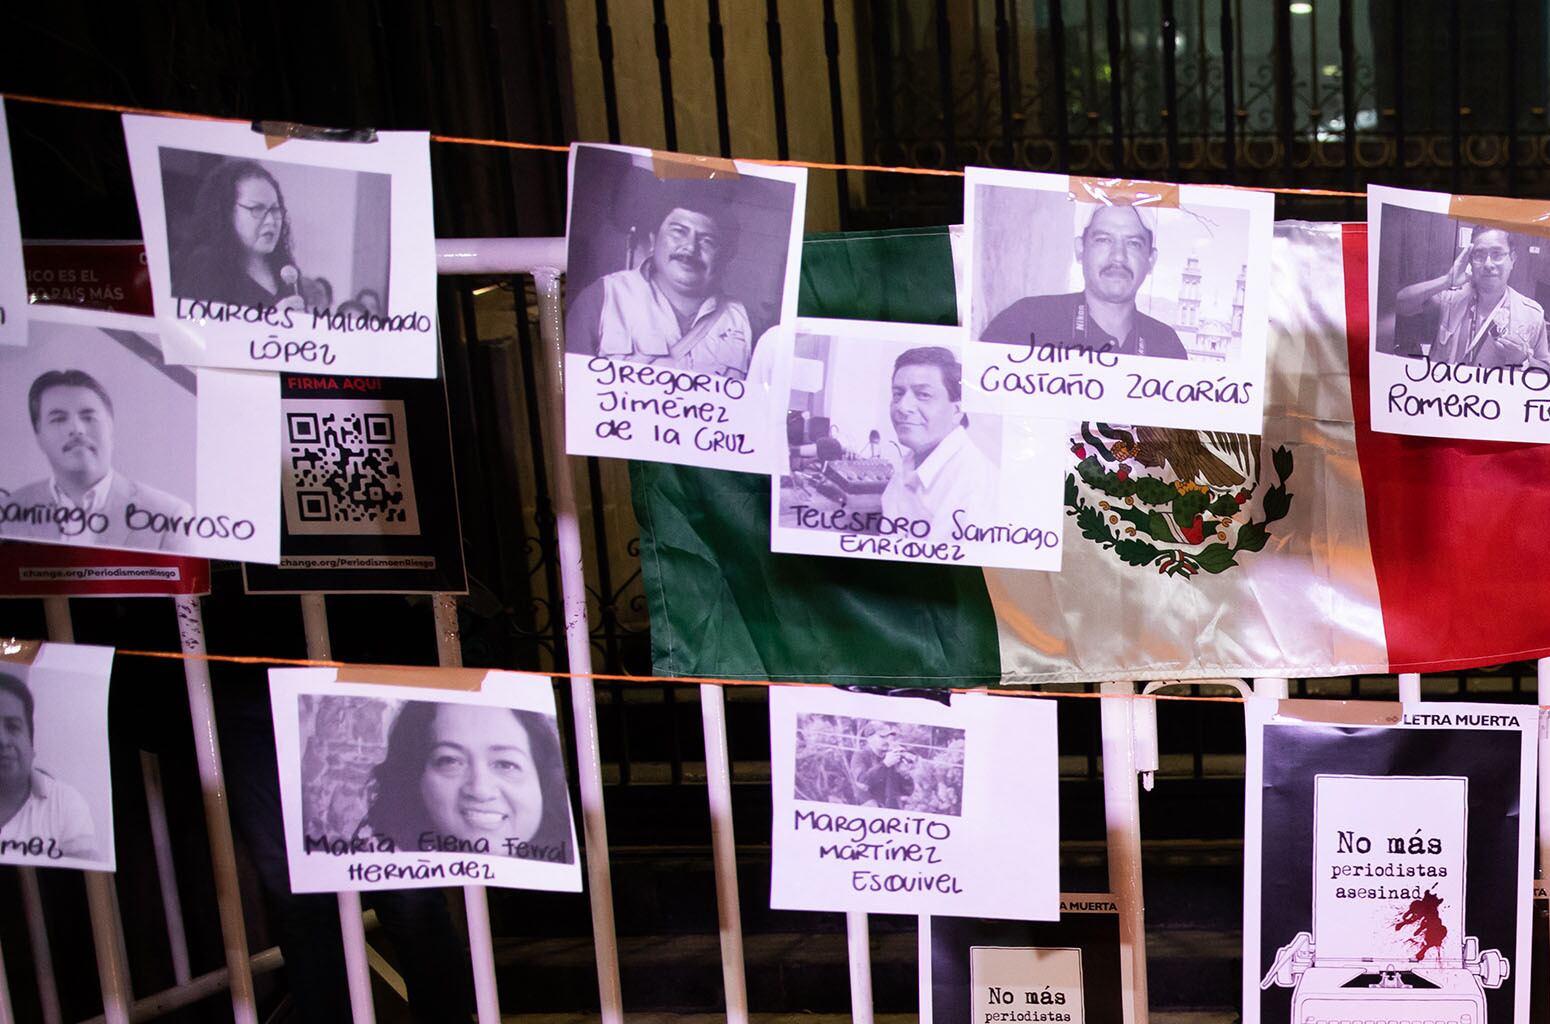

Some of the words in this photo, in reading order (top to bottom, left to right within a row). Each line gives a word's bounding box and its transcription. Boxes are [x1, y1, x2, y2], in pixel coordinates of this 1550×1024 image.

[89, 284, 124, 300] MÁS
[1007, 331, 1120, 369] Jaime
[287, 376, 339, 391] FIRMA
[595, 419, 633, 441] de
[125, 503, 256, 541] Barroso
[952, 508, 1060, 551] Santiago
[1403, 714, 1452, 726] LETRA
[1455, 714, 1520, 727] MUERTA
[0, 836, 63, 860] mez
[417, 831, 490, 854] Elena
[1337, 830, 1372, 856] No
[1386, 828, 1443, 856] más
[1330, 861, 1448, 881] periodistas
[1070, 902, 1118, 911] MUERTA
[988, 986, 1015, 1006] No
[1025, 985, 1067, 1006] más
